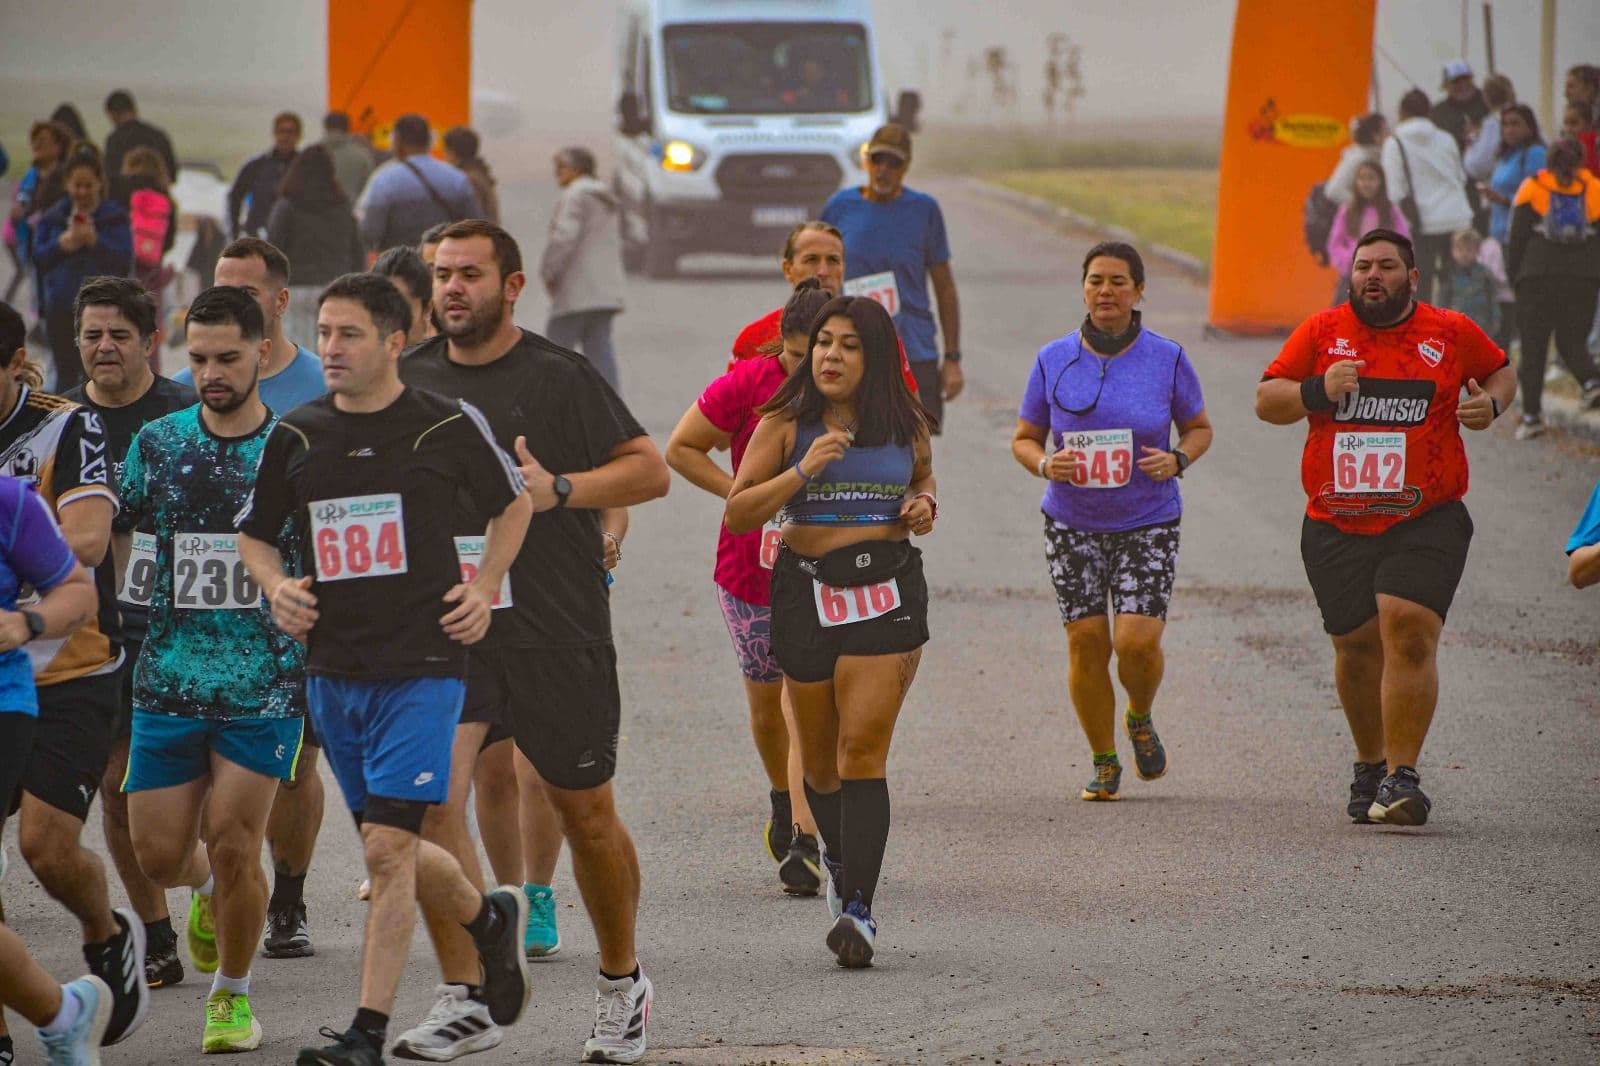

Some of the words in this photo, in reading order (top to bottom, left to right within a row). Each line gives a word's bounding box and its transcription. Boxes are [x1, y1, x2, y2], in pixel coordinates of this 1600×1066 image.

[1327, 347, 1358, 357] edbak
[1366, 436, 1403, 445] RUFF
[1070, 451, 1131, 485] 643
[1337, 452, 1403, 490] 642
[349, 501, 396, 513] RUFF
[317, 521, 404, 577] 684
[176, 559, 258, 604] 236
[820, 582, 895, 623] 616
